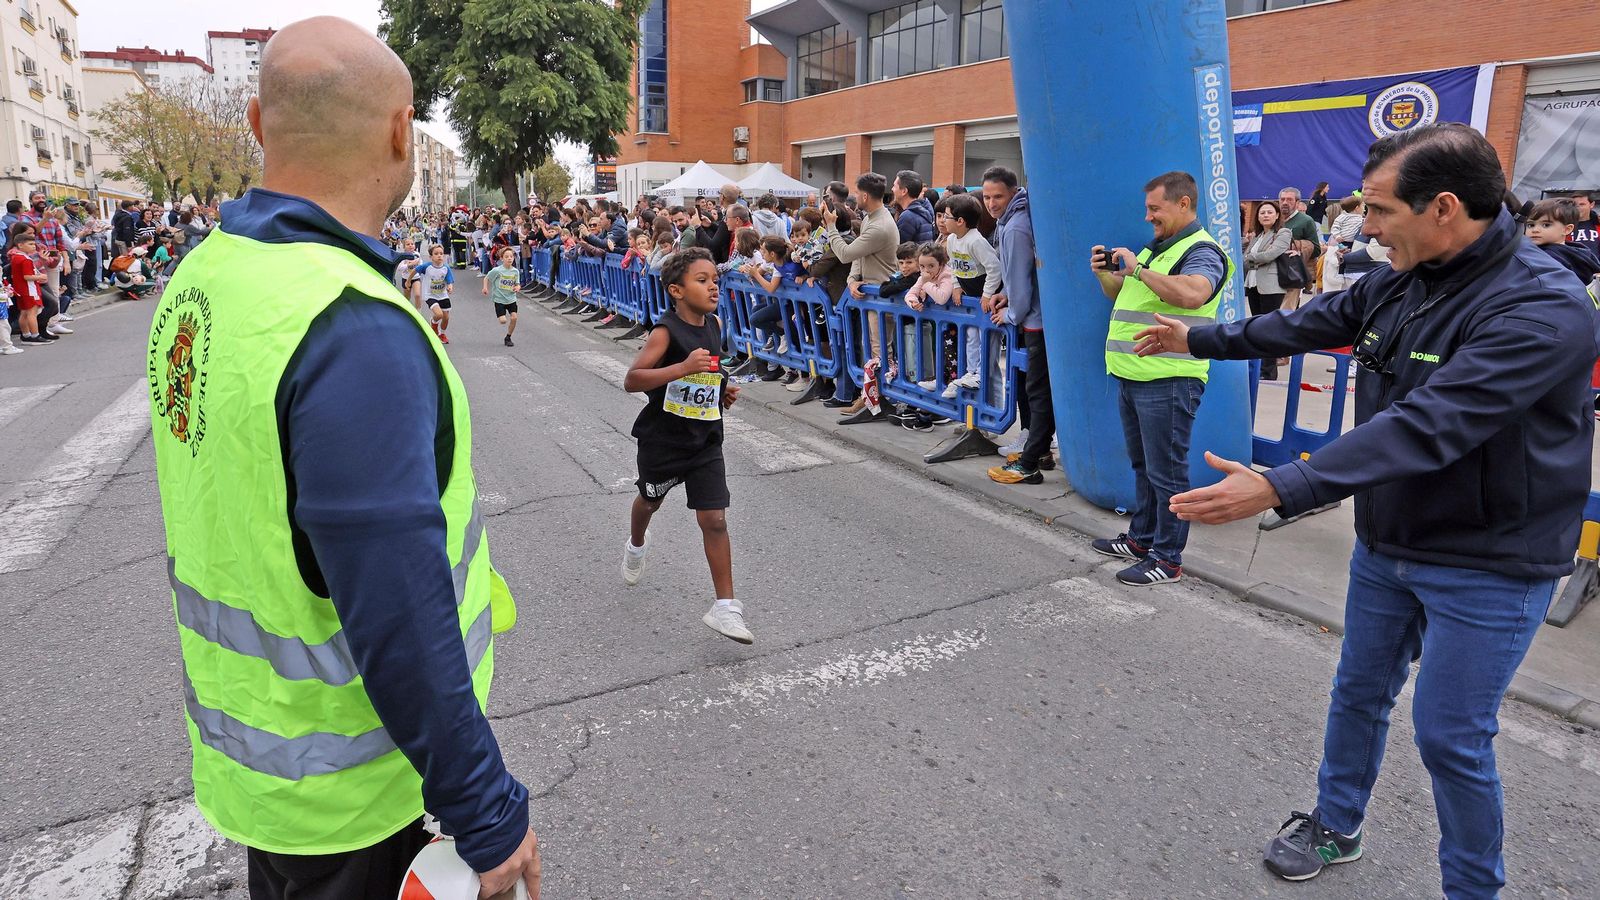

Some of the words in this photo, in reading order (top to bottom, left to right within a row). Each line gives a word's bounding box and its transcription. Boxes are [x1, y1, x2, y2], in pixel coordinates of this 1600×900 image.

[1376, 86, 1405, 110] BOMBEROS
[1420, 90, 1434, 118] PROVINCIA
[1204, 71, 1236, 324] deportes@aytoez.e
[1570, 229, 1599, 242] AP
[174, 289, 188, 309] DE
[188, 286, 212, 365] BOMBEROS
[198, 372, 208, 403] DE
[680, 385, 716, 405] 164
